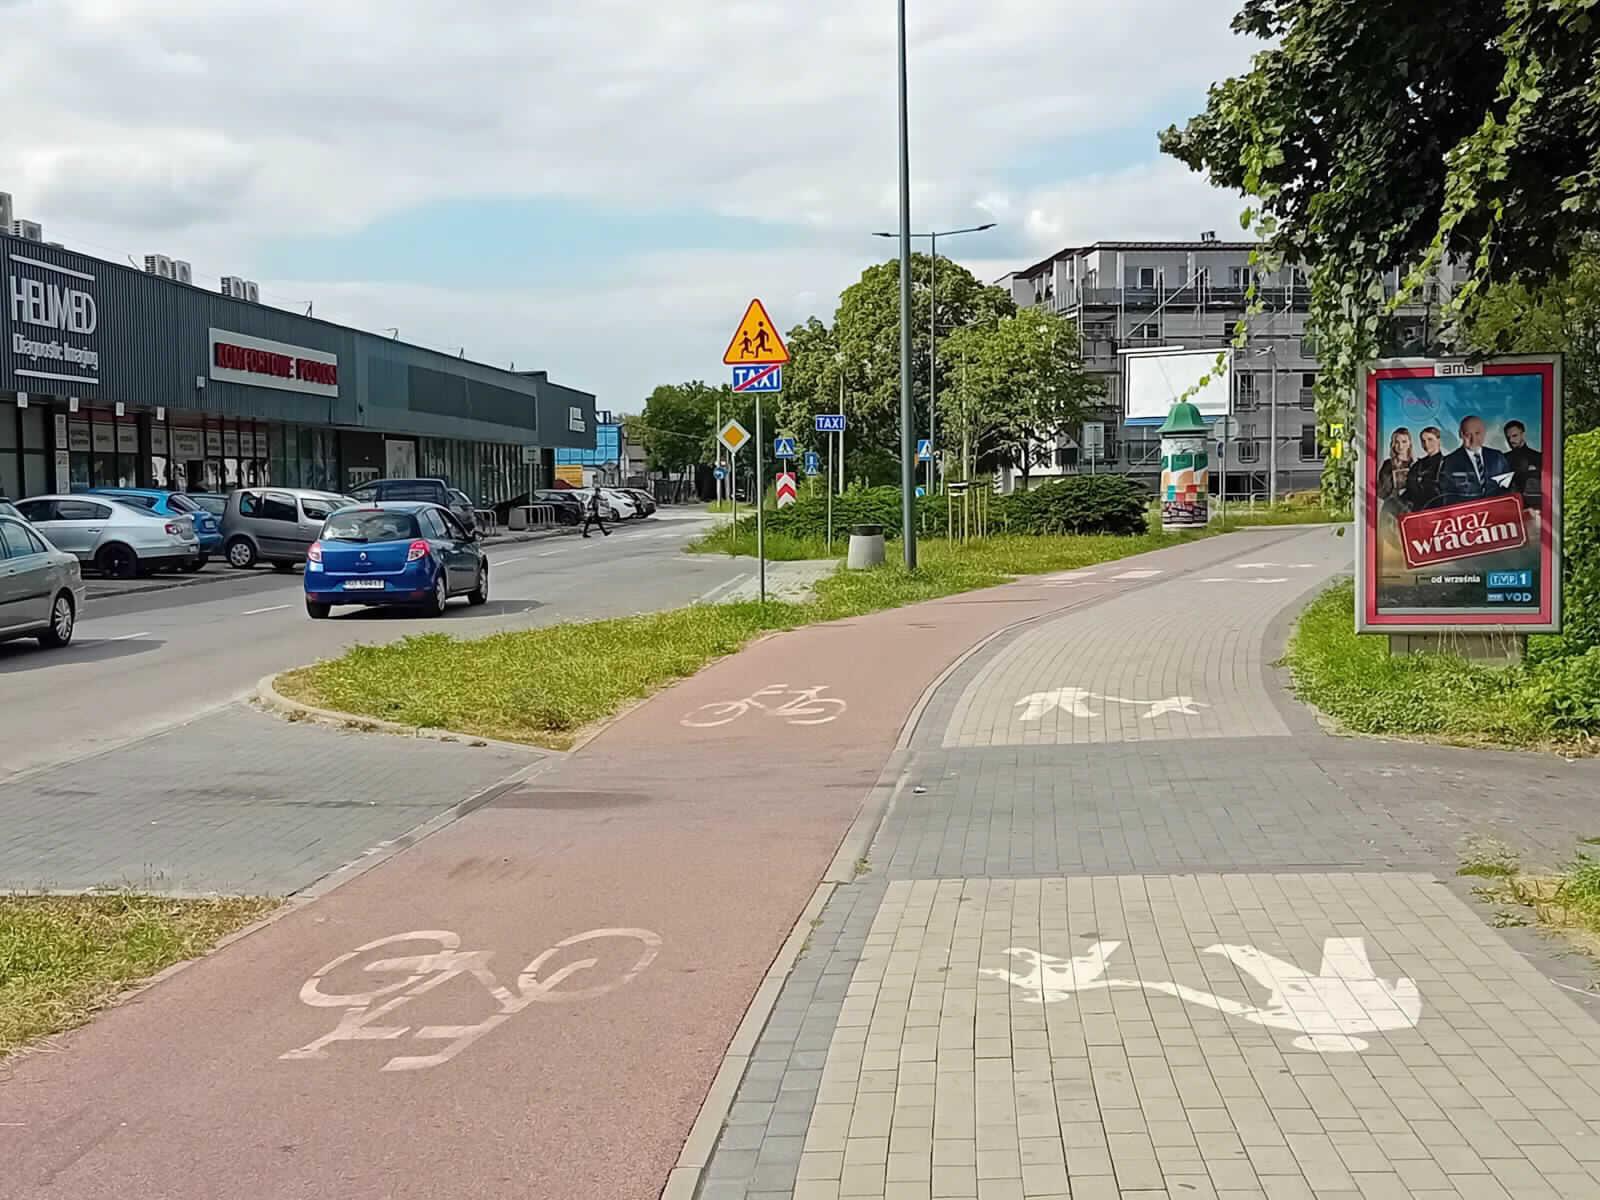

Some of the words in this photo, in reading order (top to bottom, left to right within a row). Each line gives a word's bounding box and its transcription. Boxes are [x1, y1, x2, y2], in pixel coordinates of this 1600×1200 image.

[1442, 364, 1474, 375] ams
[735, 368, 778, 387] TAXI
[818, 417, 843, 429] TAXI
[1432, 511, 1493, 535] zaraz
[1411, 522, 1519, 555] wracam
[1431, 575, 1442, 584] od
[1490, 573, 1518, 585] TVP
[1505, 592, 1533, 602] VOD
